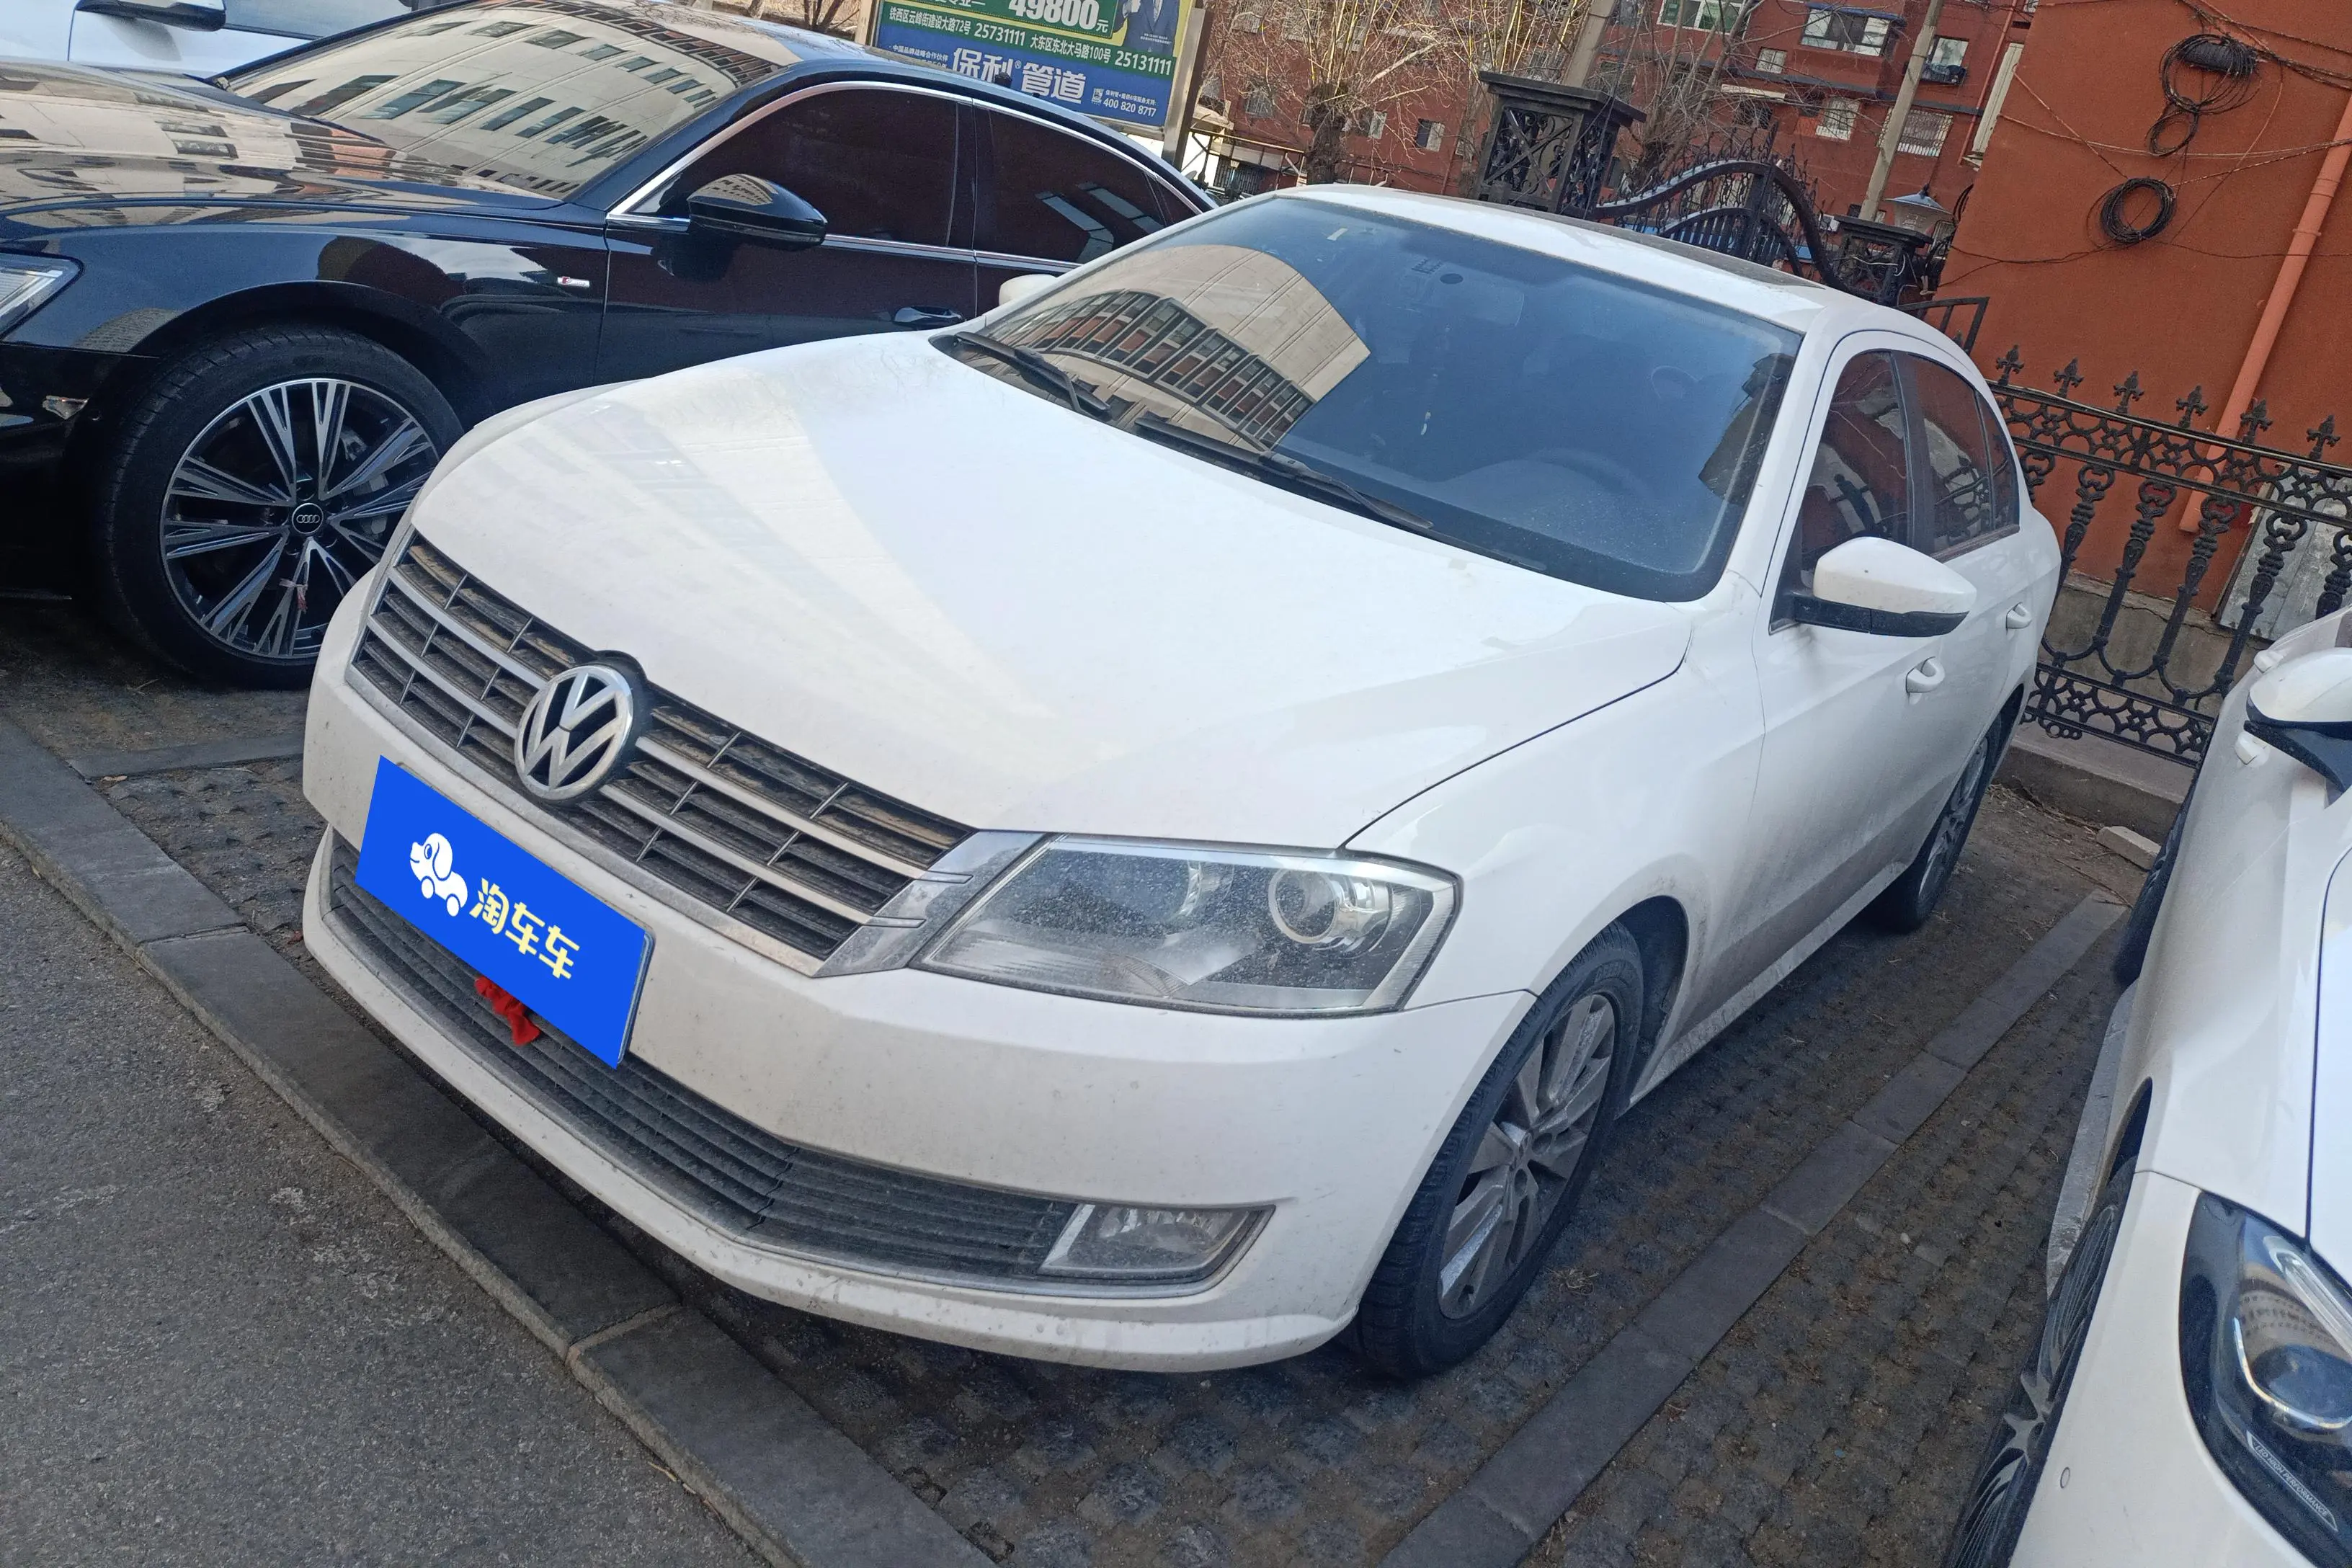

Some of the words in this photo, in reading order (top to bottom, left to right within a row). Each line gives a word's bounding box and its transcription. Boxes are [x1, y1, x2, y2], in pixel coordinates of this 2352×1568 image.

[889, 6, 971, 35] 铁西区云峰街建设大路72号
[974, 22, 1026, 46] 25731111
[1030, 34, 1111, 63] 大东区东北大马路100号
[1114, 50, 1172, 76] 25131111
[1102, 98, 1118, 109] 400
[1121, 102, 1136, 112] 820
[1137, 104, 1157, 117] 8717
[2255, 1446, 2268, 1458] LED
[2282, 1471, 2330, 1517] PERFORMANCE
